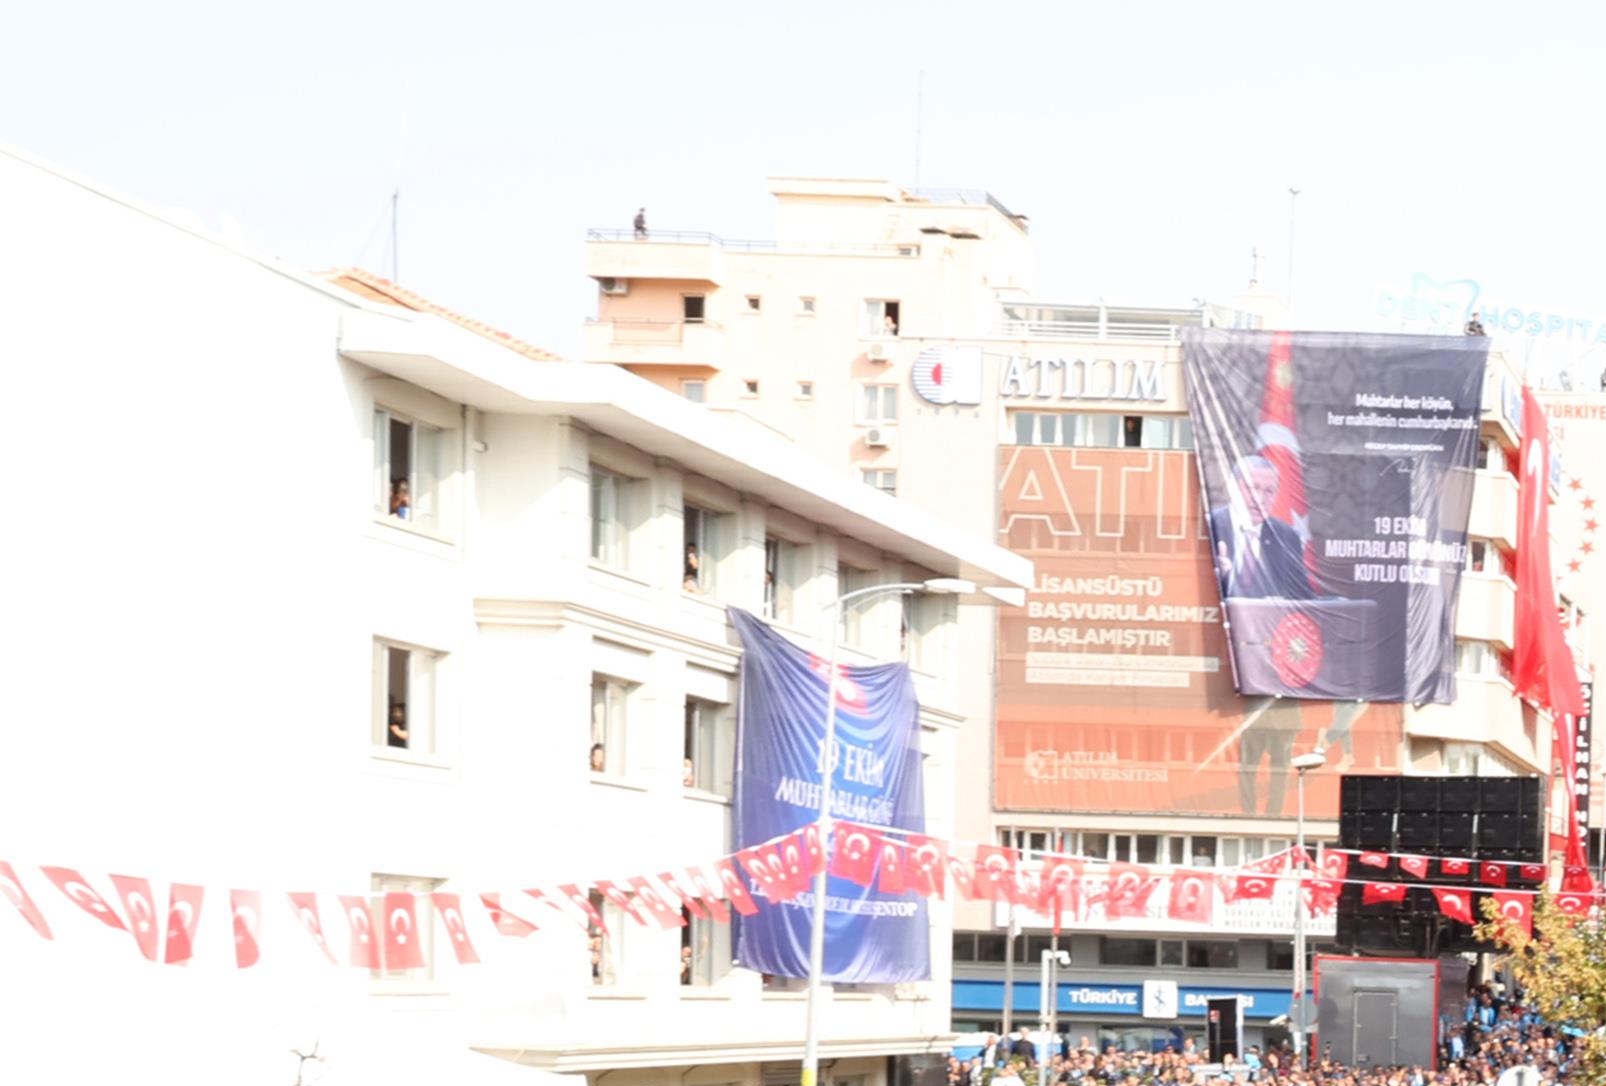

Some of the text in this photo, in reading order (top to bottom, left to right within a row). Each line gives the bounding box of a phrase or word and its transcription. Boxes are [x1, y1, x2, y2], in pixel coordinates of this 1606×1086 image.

[1000, 353, 1168, 402] ATILIM
[1403, 395, 1420, 410] her
[1327, 411, 1345, 426] her
[1000, 448, 1210, 540] ATI
[1374, 514, 1427, 537] 19 EKİM
[1325, 539, 1407, 558] MUHTARLAR
[1354, 563, 1398, 582] KUTLU
[1028, 573, 1164, 597] LİSANSÜSTÜ
[1027, 601, 1220, 624] BAŞVURULARIMIZ
[1027, 626, 1171, 649] BAŞLAMIŞTIR
[842, 742, 886, 789] EKİM
[1060, 751, 1119, 765] ATILIM
[1060, 765, 1169, 784] ÜNİVERSİTESİ
[774, 775, 869, 822] MUHARLAR
[1069, 988, 1254, 1009] TÜRKİYE BASI
